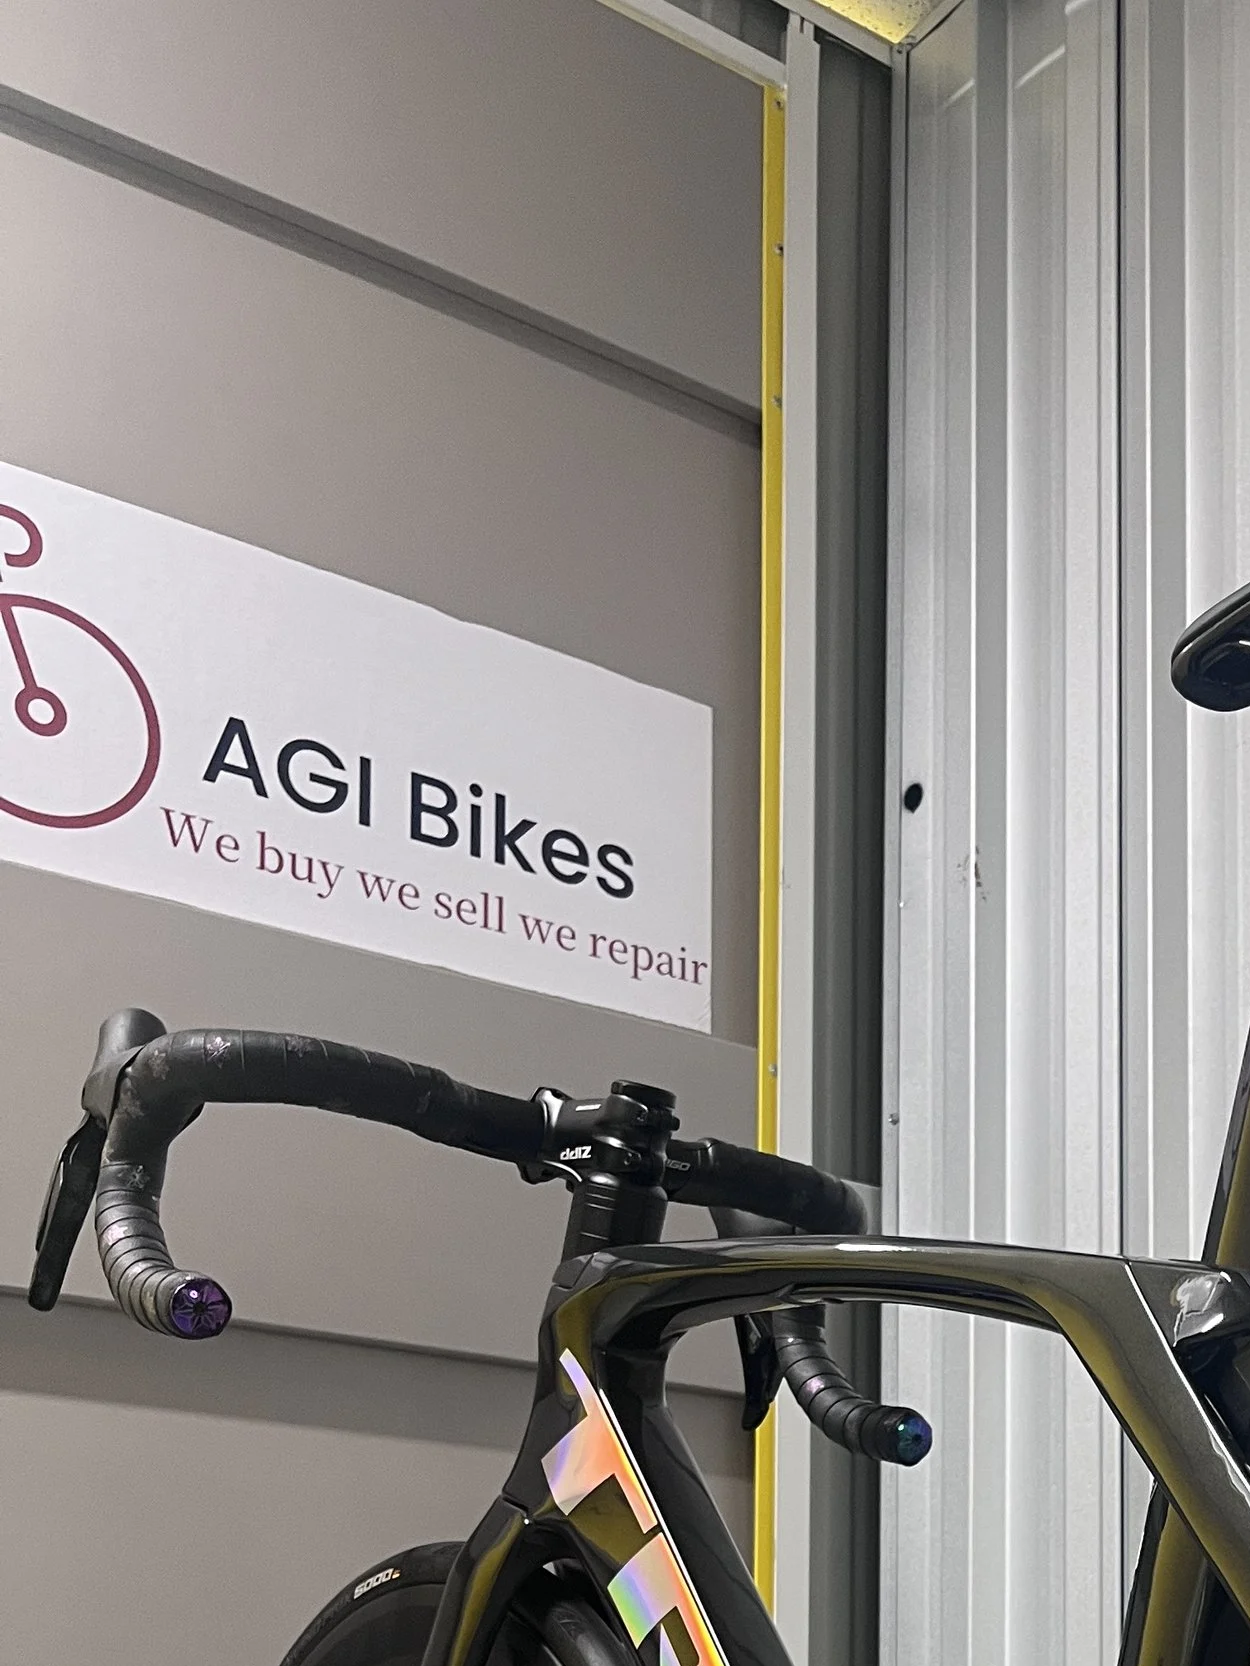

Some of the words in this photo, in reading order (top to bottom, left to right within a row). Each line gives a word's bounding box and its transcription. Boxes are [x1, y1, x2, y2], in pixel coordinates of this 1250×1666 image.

[160, 806, 240, 863] We
[256, 830, 345, 899] buy
[356, 870, 420, 911] we
[434, 890, 506, 934] sell
[518, 912, 577, 952] we
[589, 932, 708, 986] repair
[203, 716, 372, 828] AGI
[409, 771, 635, 899] Bikes
[354, 1567, 394, 1600] 5000
